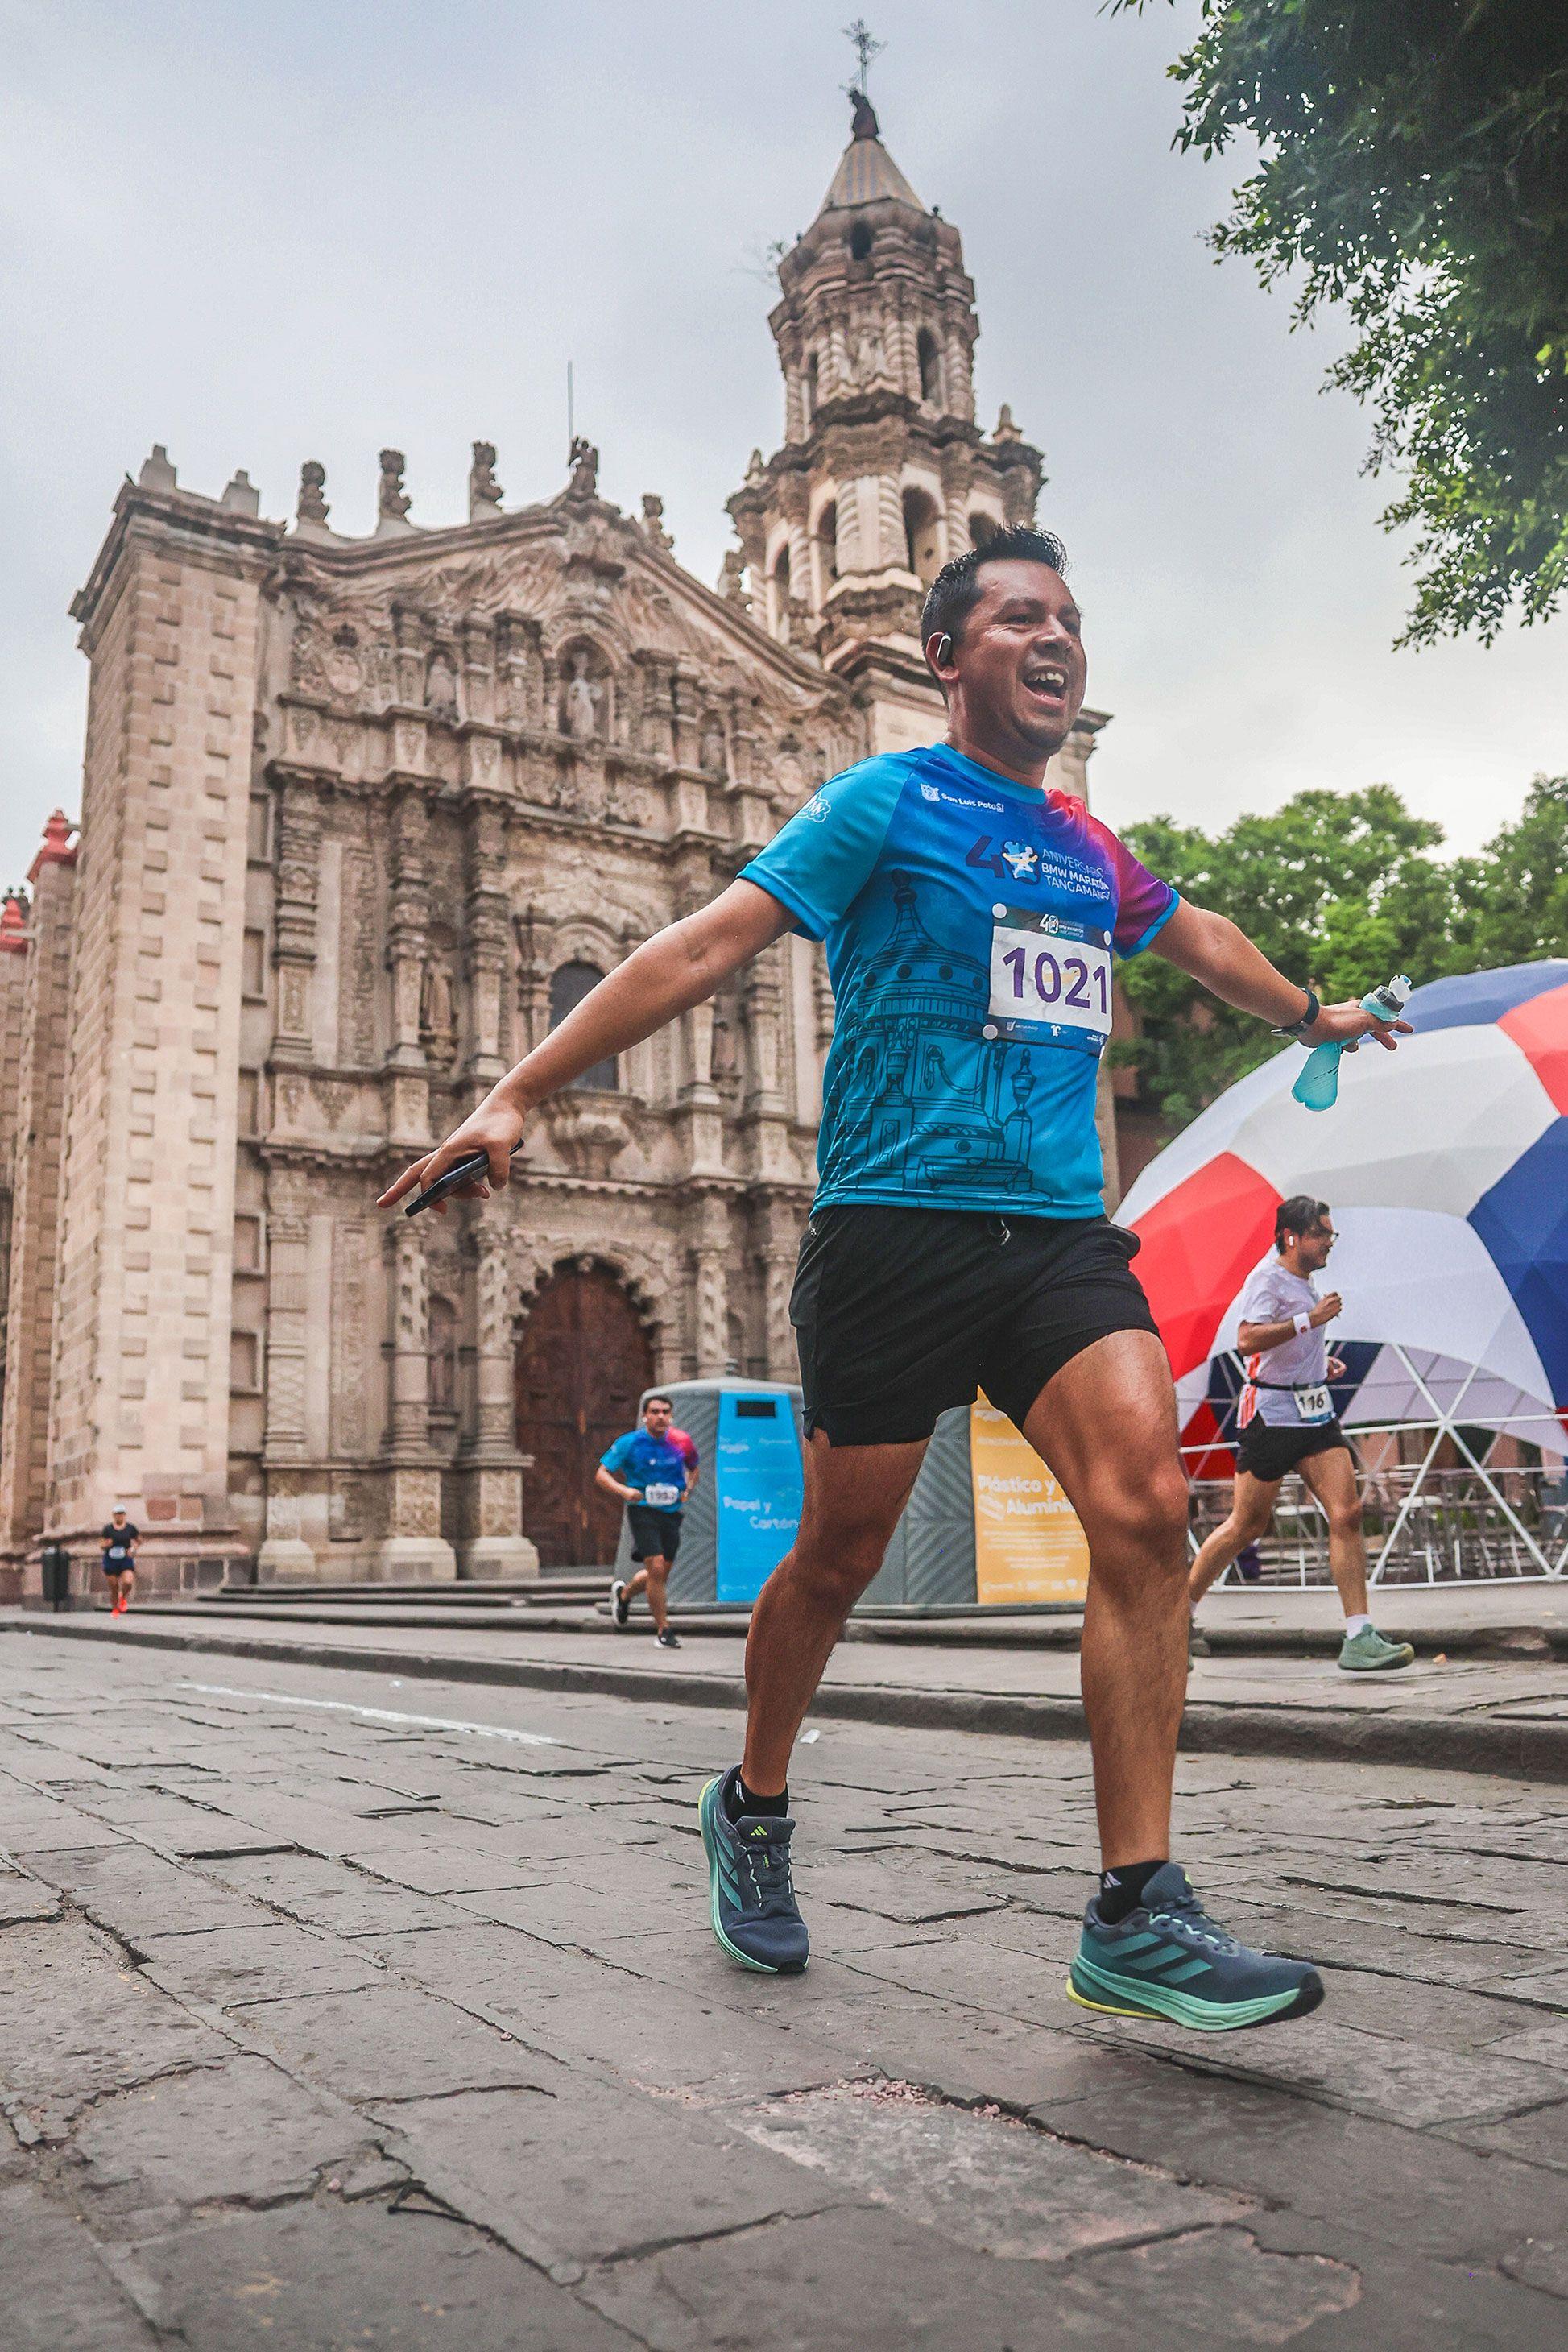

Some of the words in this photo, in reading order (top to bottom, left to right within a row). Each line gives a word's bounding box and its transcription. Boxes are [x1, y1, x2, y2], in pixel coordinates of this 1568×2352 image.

[958, 797, 977, 807] Luis
[1041, 862, 1068, 879] BMW
[1002, 946, 1107, 1015] 1021
[978, 1473, 1043, 1493] Plástico
[1044, 1478, 1057, 1497] y
[763, 1501, 772, 1515] y
